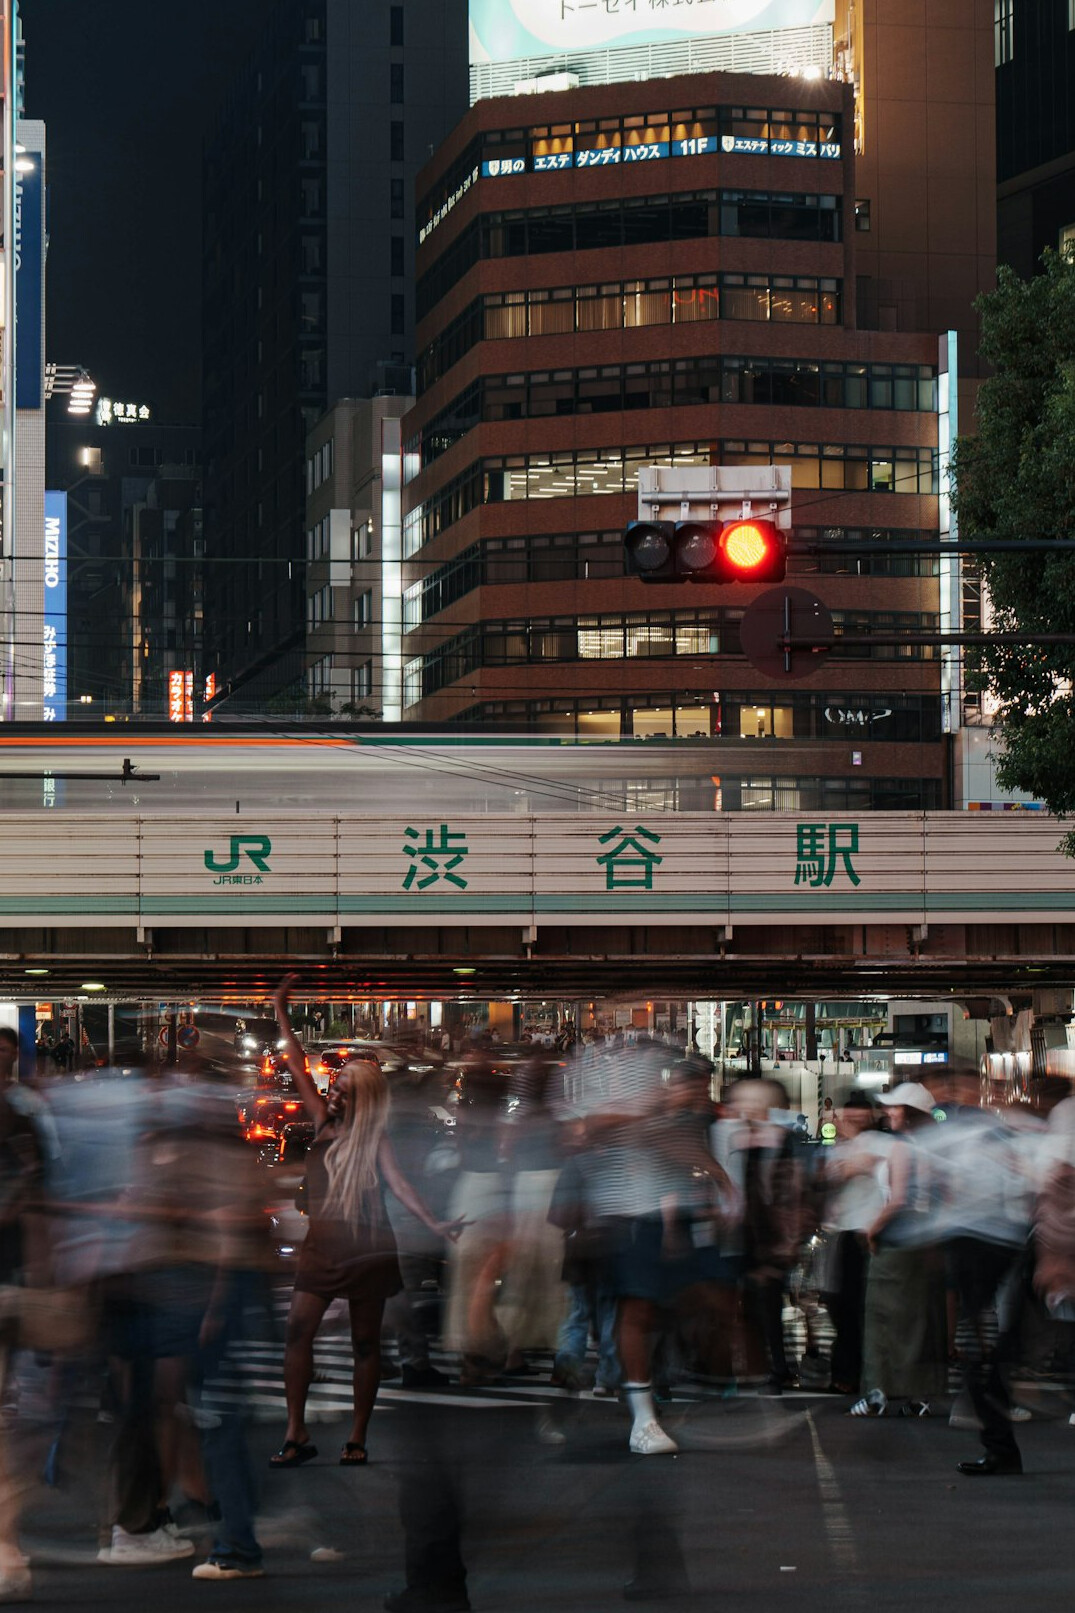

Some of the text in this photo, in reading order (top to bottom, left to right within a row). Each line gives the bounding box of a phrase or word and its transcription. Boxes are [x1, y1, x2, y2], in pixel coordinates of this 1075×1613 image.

[500, 159, 526, 175] 男の
[534, 154, 570, 170] エステ
[680, 137, 709, 156] 11F
[44, 517, 60, 588] MIZUHO
[170, 672, 183, 722] カラオケ
[43, 778, 56, 807] 銀行
[204, 835, 272, 872] JR
[213, 875, 264, 885] JR東日本
